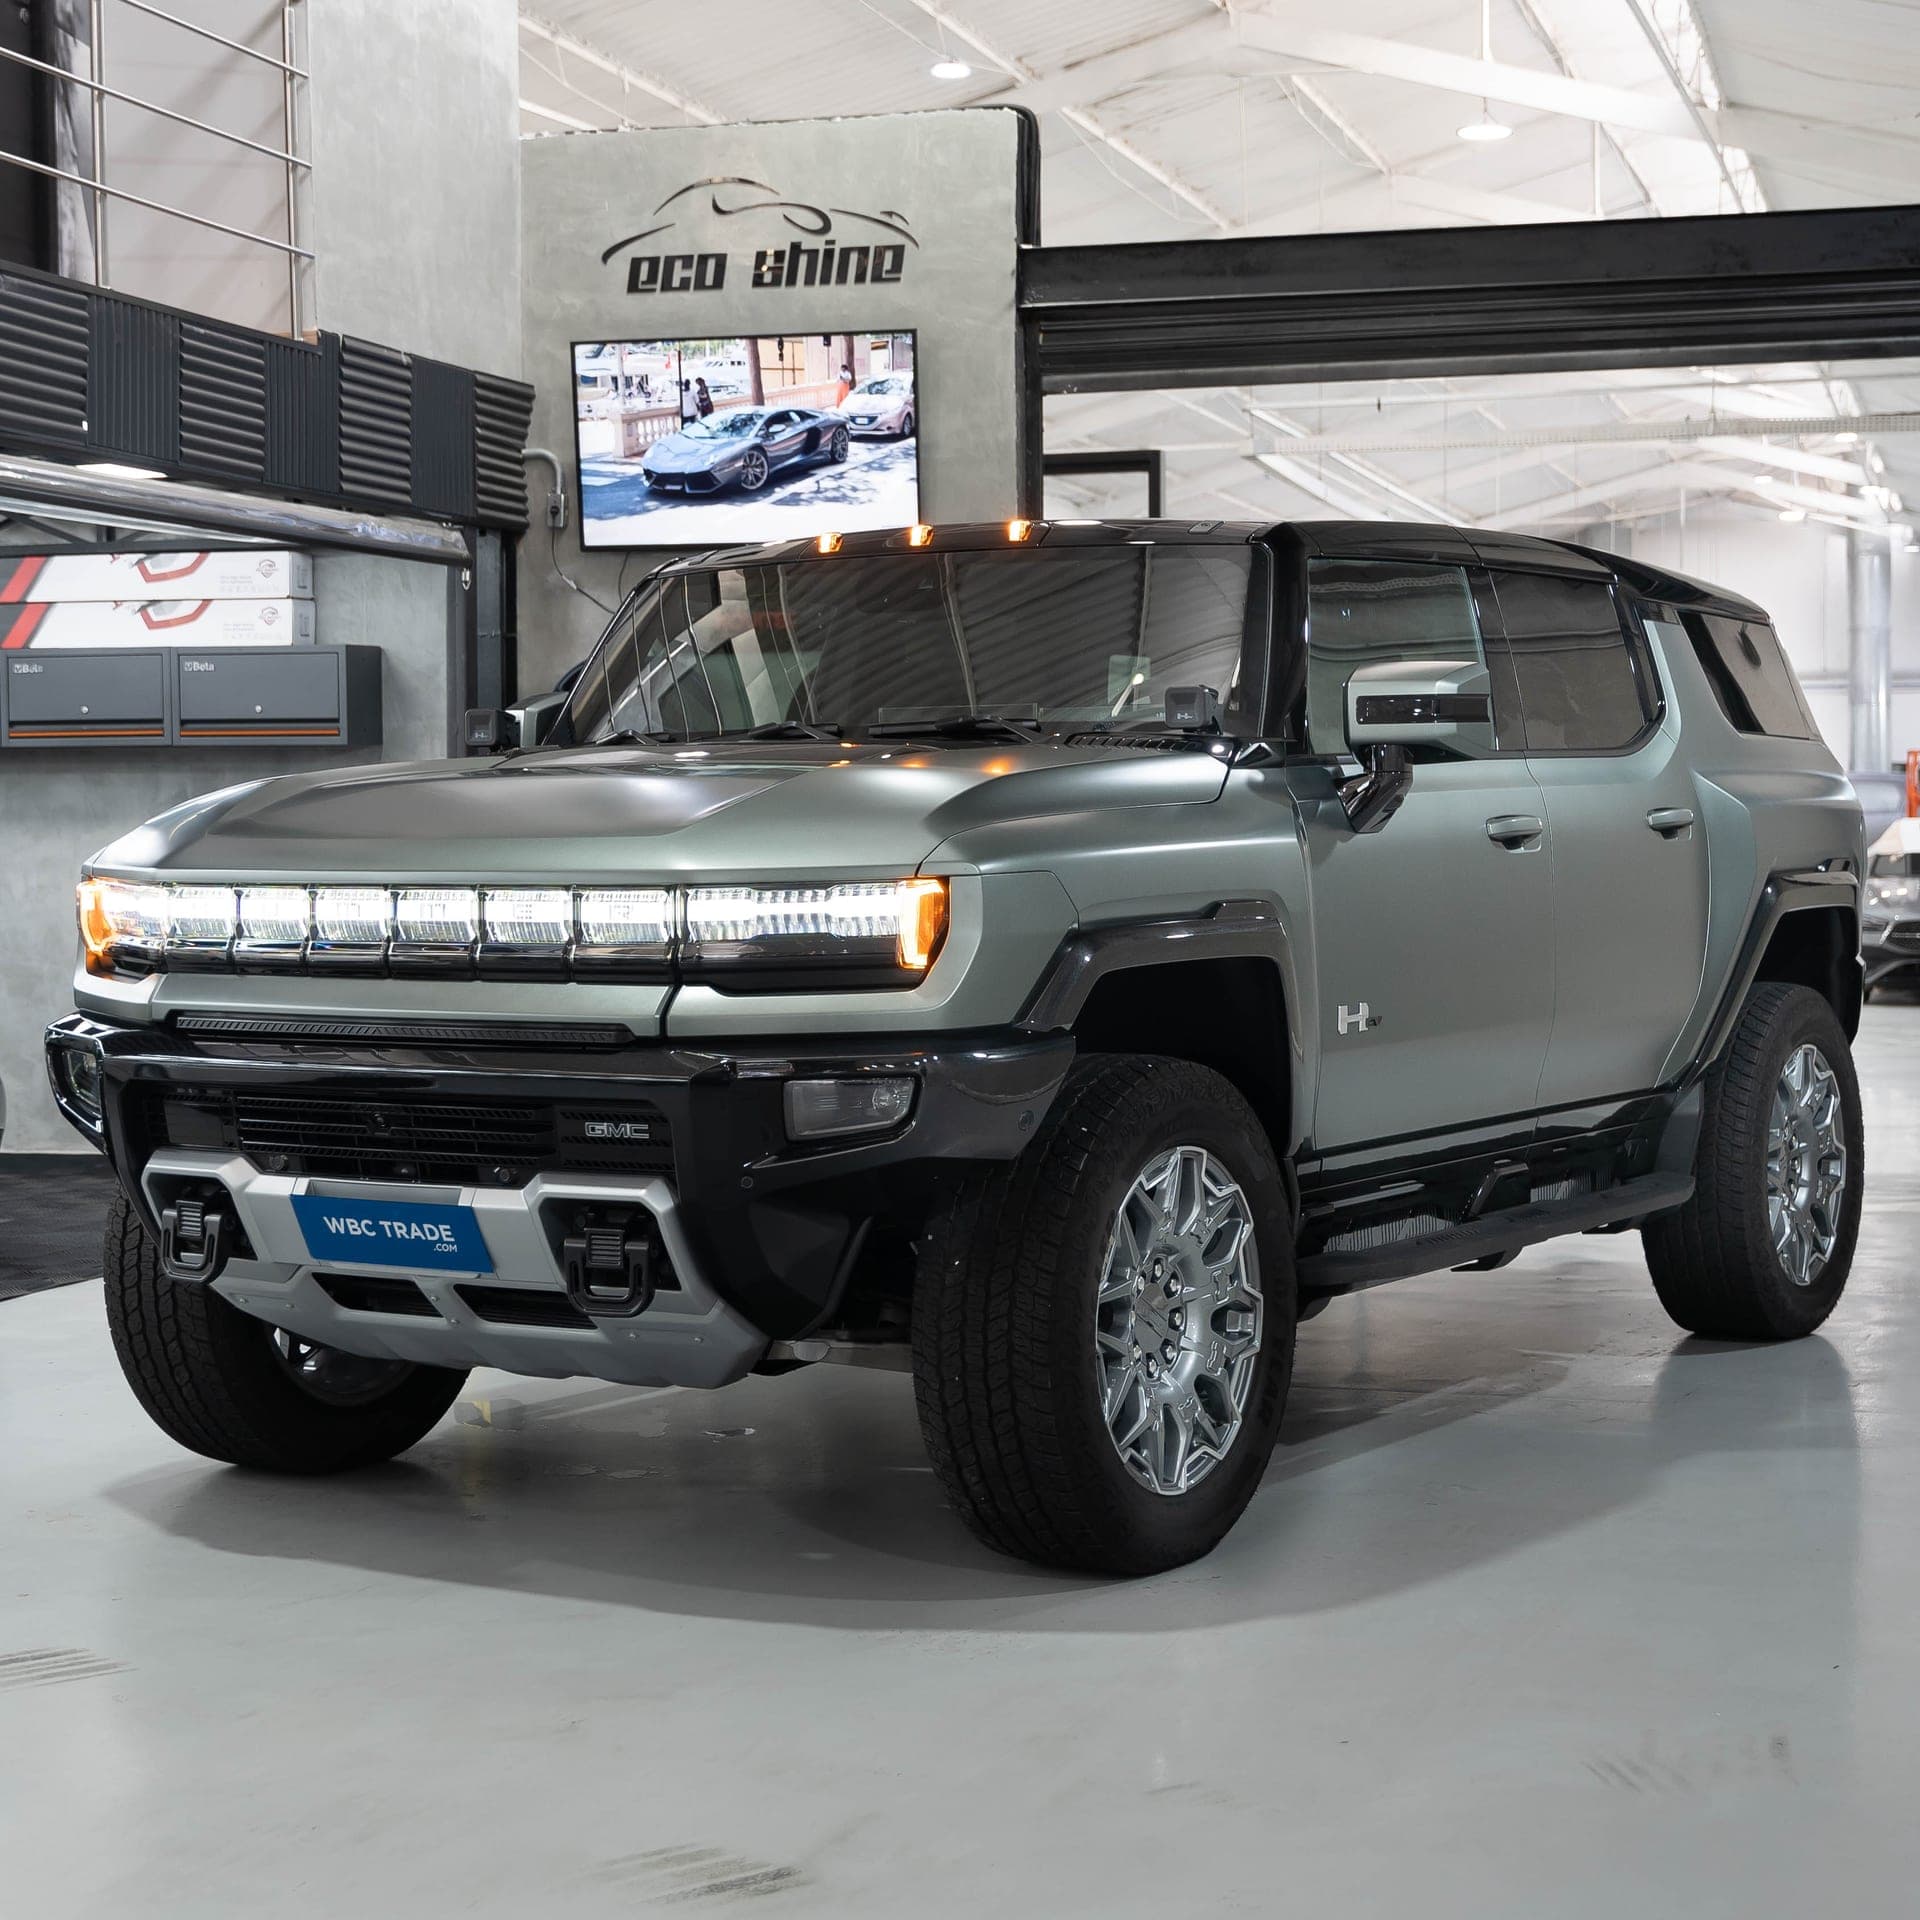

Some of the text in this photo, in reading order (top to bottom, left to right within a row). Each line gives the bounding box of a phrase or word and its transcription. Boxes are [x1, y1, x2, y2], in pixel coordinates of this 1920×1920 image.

[627, 239, 906, 294] eco shine
[584, 1122, 649, 1139] GMC
[323, 1216, 456, 1242] WBC TRADE
[433, 1243, 458, 1253] .COM
